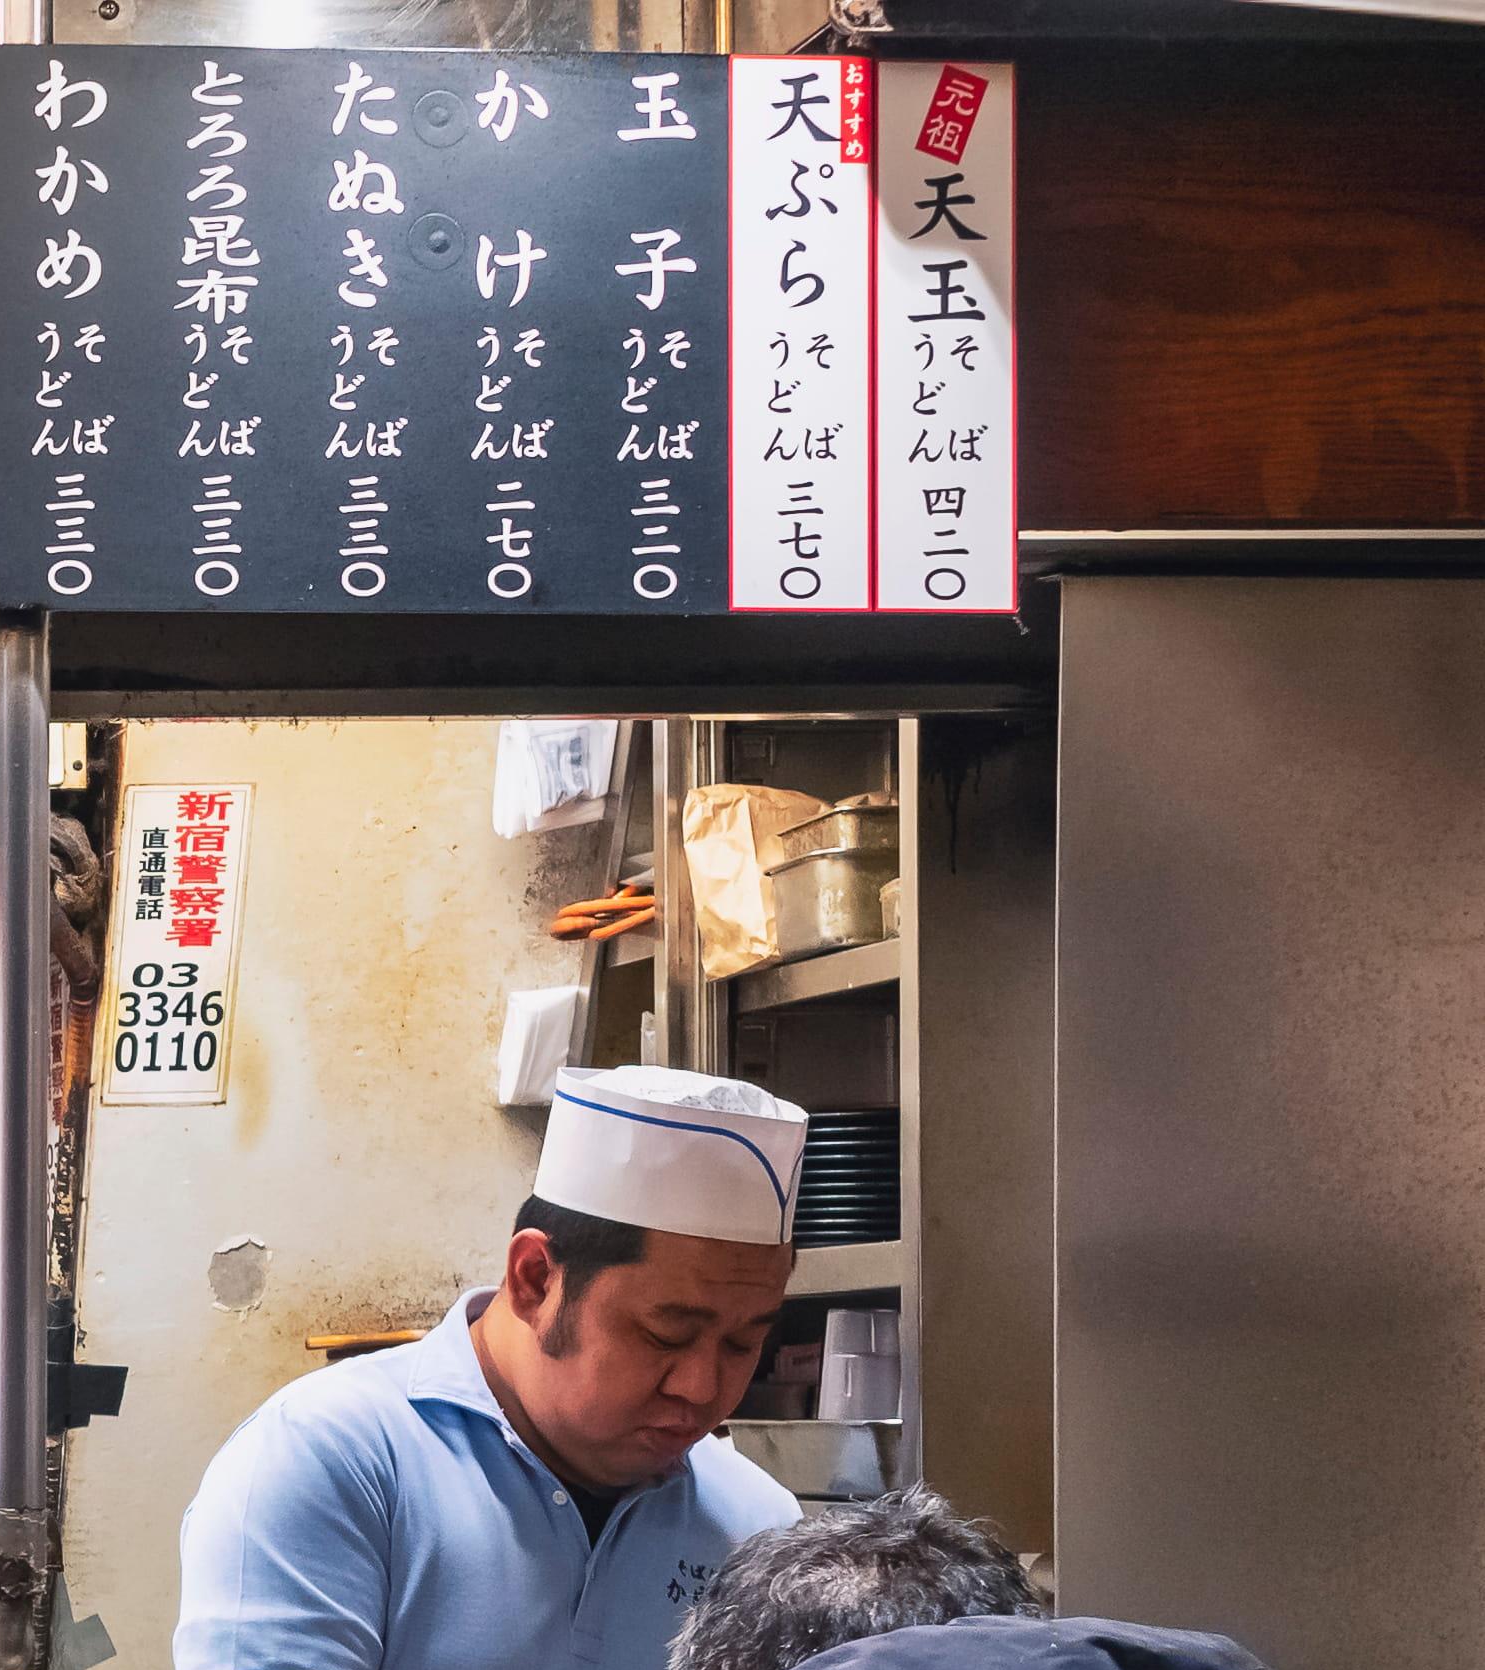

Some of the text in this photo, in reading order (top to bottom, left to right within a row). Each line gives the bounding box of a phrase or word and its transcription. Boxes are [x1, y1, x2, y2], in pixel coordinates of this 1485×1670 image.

[845, 65, 864, 159] おすすめ
[926, 78, 975, 156] 元祖
[34, 59, 109, 299] わかめ
[173, 60, 261, 325] とろろ昆布
[328, 59, 405, 308] たぬき
[470, 65, 552, 308] かけ
[614, 71, 697, 311] 玉子
[765, 73, 842, 308] 天ぷら
[907, 172, 989, 323] 天玉
[45, 473, 96, 595] 三三〇
[192, 474, 242, 596] 三三〇
[338, 475, 389, 597] 三三〇
[485, 481, 536, 598] 二七〇
[630, 478, 681, 599] 三二〇
[777, 481, 824, 600] 三七〇
[922, 486, 970, 601] 四二〇
[135, 826, 171, 921] 直通電話
[165, 790, 234, 948] 新宿警察署
[118, 990, 224, 1028] 3346
[132, 962, 200, 988] 03
[114, 1030, 218, 1073] 0110
